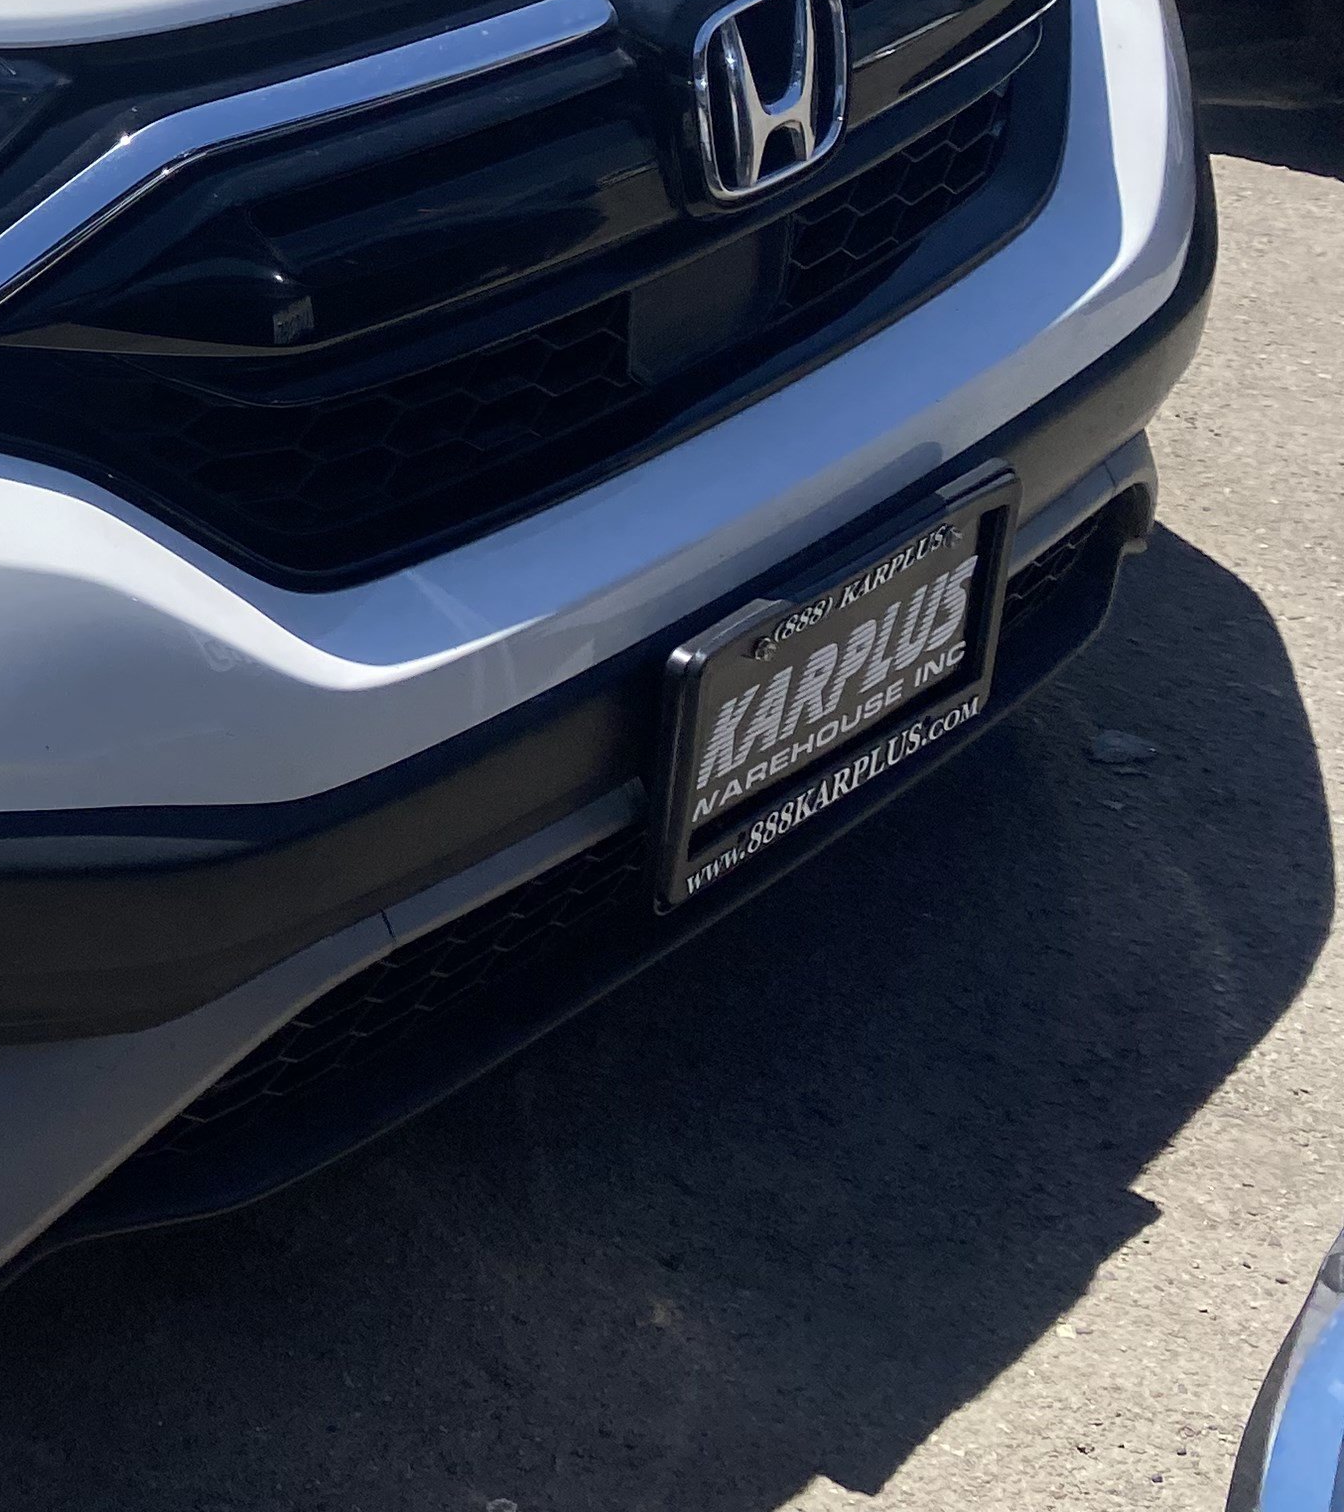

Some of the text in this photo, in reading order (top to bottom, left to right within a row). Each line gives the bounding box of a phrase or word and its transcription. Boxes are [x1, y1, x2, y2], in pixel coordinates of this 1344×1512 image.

[774, 523, 948, 642] (888) KARPLUS
[696, 554, 978, 790] KARPLUS
[914, 640, 967, 688] INC
